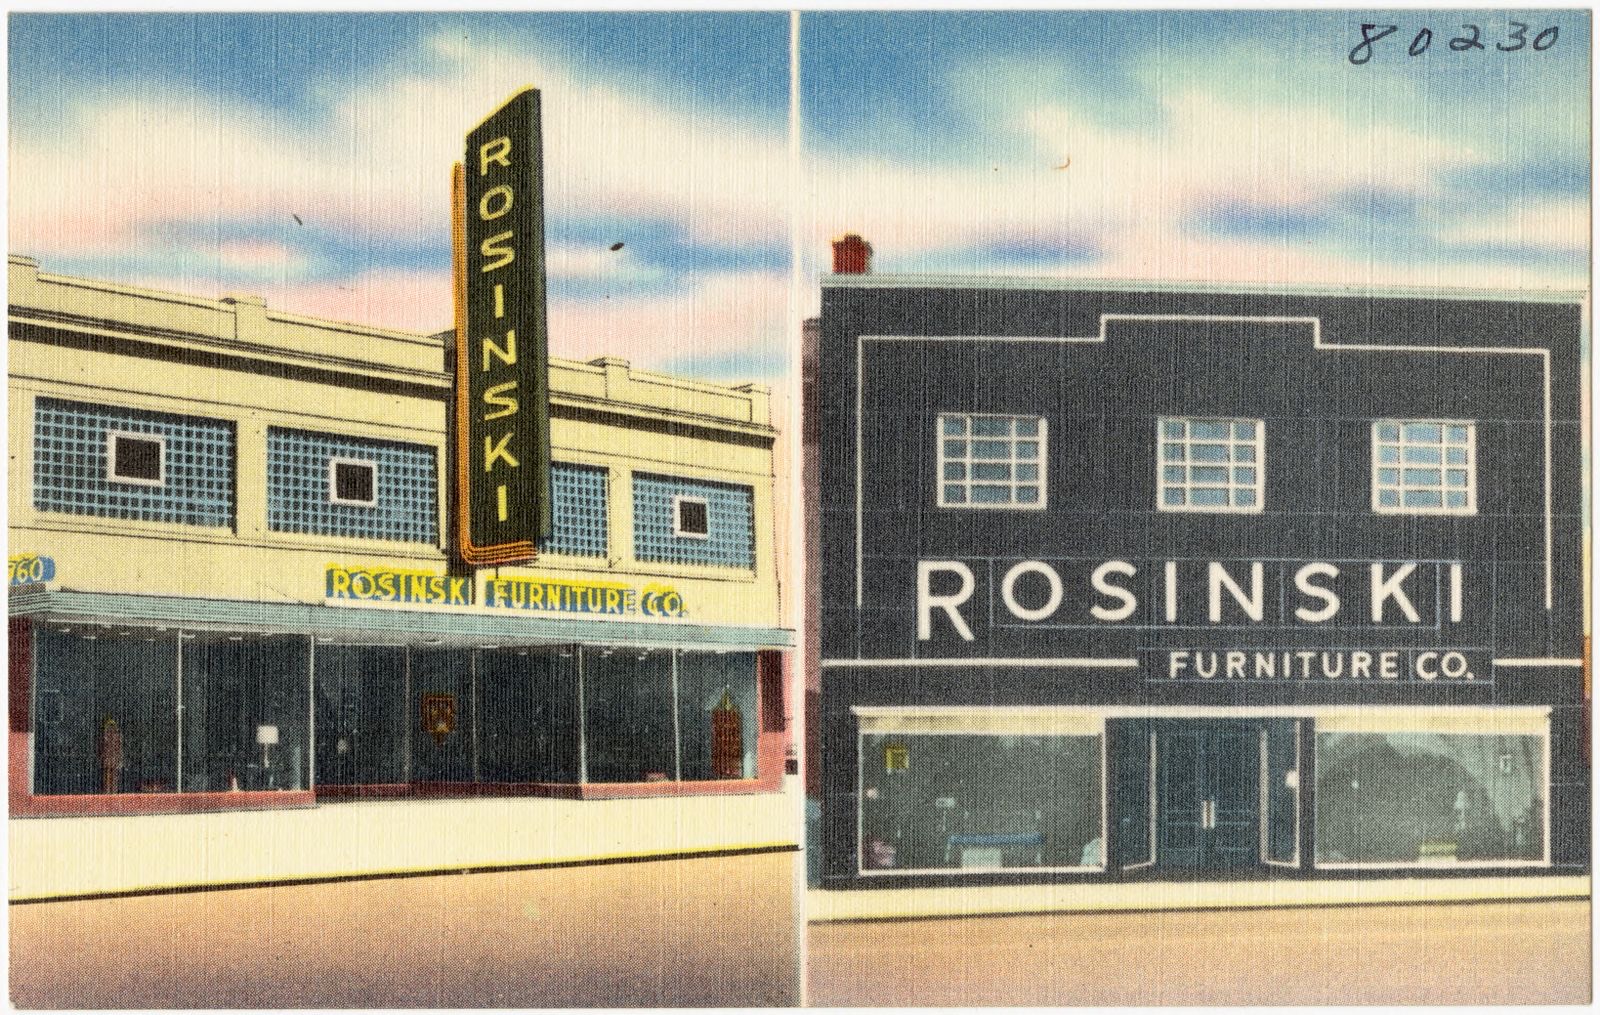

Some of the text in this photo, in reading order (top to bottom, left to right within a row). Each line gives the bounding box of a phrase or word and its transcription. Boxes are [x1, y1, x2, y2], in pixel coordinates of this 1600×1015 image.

[1349, 20, 1559, 65] 80230
[479, 135, 518, 522] ROSINSKI
[492, 579, 636, 614] FURNITURE
[916, 559, 1463, 642] ROSINSKI
[1168, 650, 1476, 681] FURNITURE CO.
